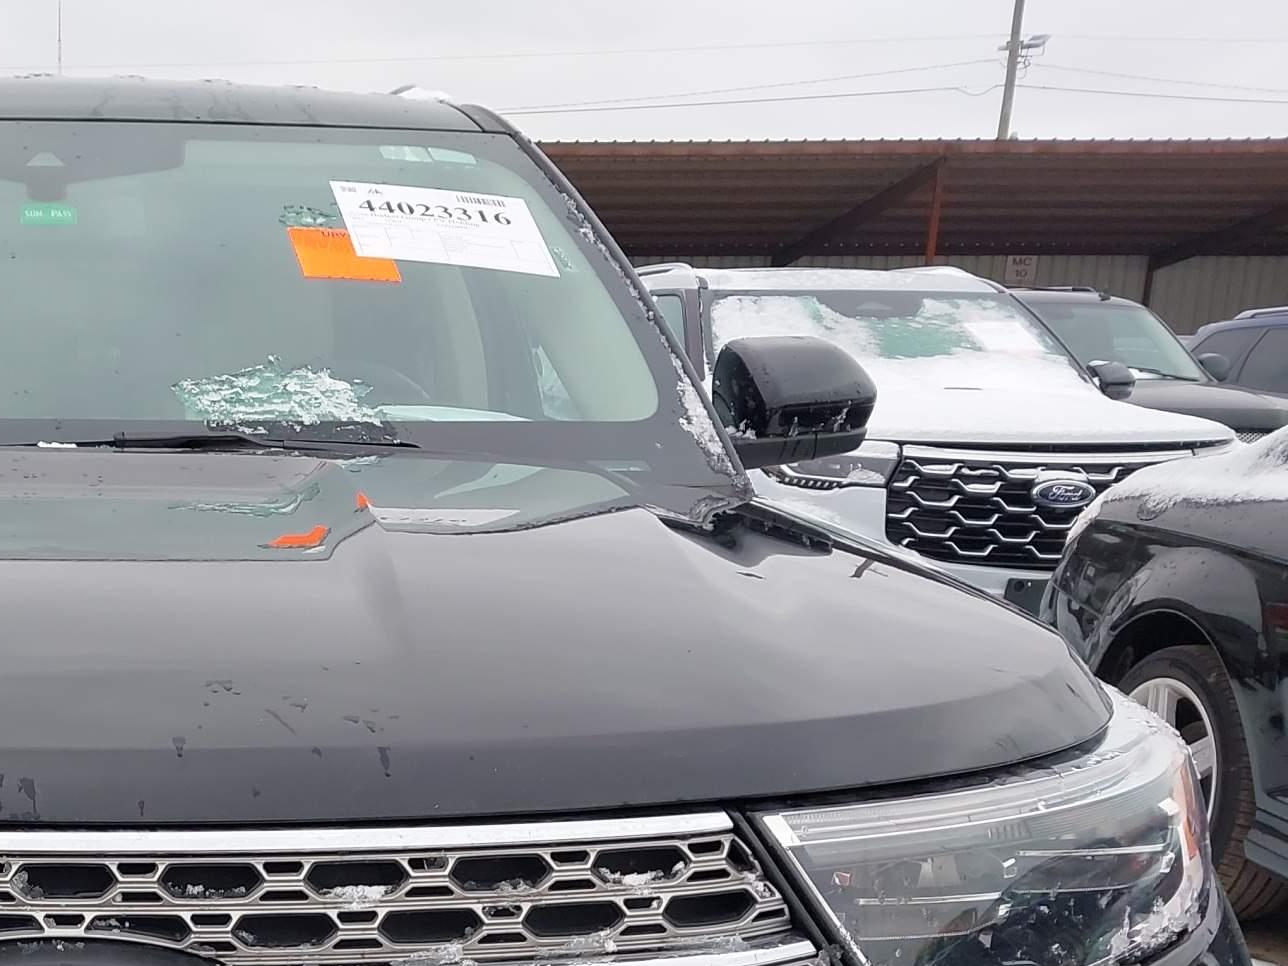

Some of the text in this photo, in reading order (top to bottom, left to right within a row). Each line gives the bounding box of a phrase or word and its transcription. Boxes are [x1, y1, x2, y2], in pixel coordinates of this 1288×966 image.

[358, 199, 512, 226] 44023316
[1012, 256, 1033, 266] MC
[1048, 485, 1083, 501] Ford
